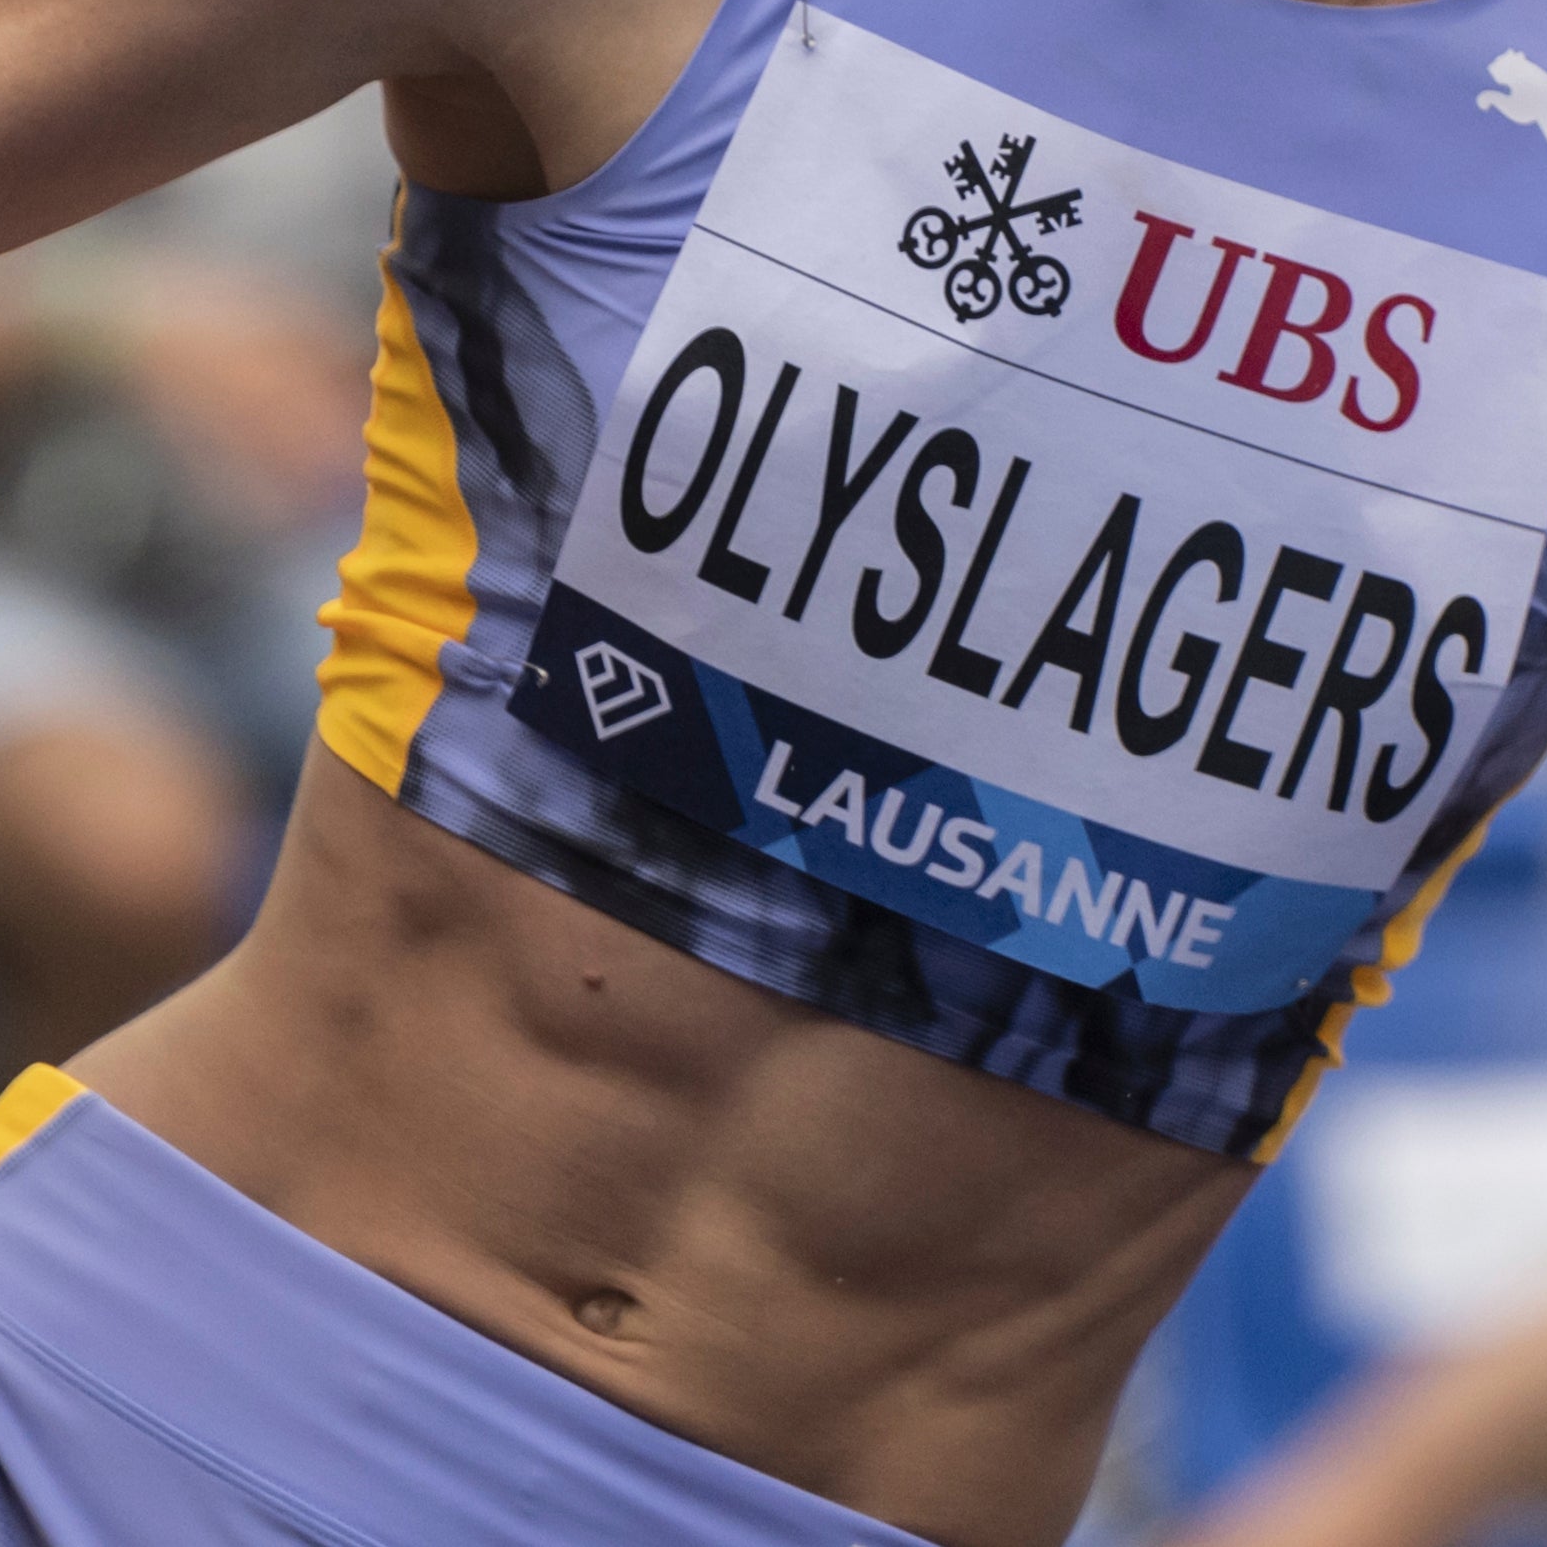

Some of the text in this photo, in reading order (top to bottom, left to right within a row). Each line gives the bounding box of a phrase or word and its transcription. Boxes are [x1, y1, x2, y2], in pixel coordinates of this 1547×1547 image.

[1113, 210, 1437, 432] UBS
[620, 326, 1486, 823] OLYSLAGERS
[754, 741, 1236, 968] LAUSANNE
